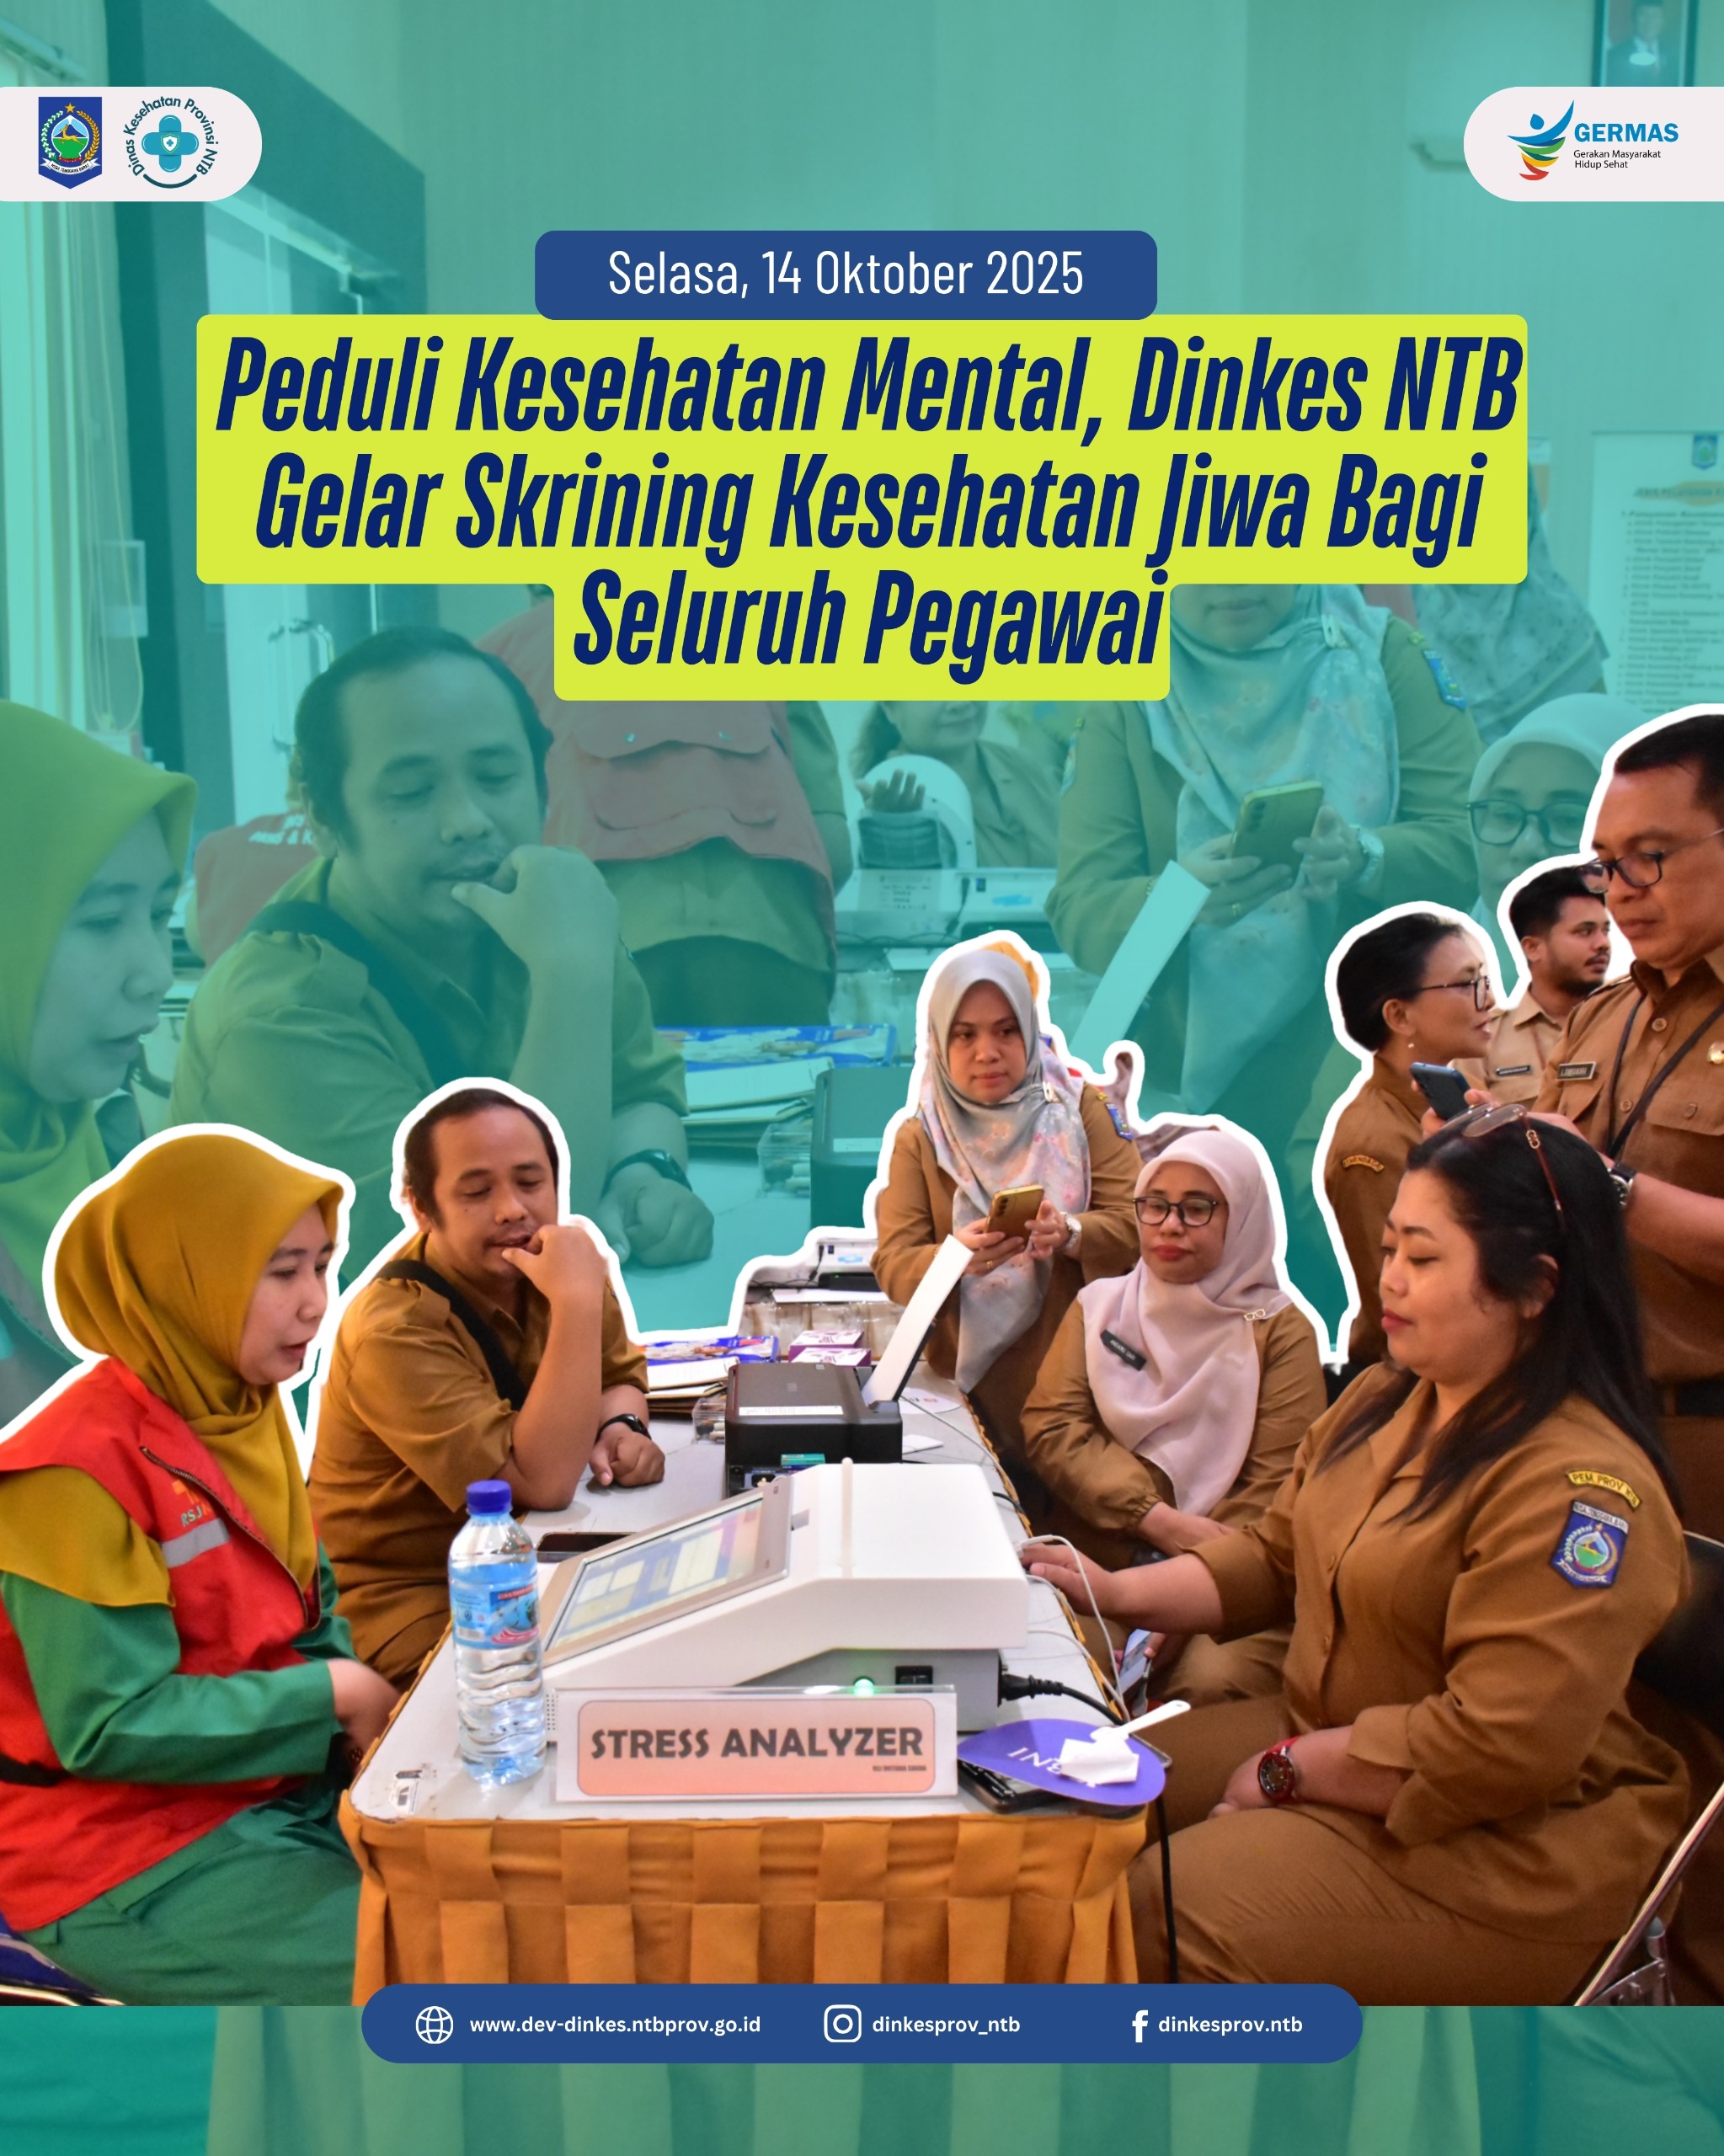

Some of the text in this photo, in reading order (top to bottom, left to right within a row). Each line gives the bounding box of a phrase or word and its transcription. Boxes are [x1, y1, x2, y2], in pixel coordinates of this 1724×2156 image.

[1572, 1472, 1593, 1483] PEM
[1597, 1476, 1624, 1491] PROV
[592, 1727, 923, 1758] STRESS ANALYZER
